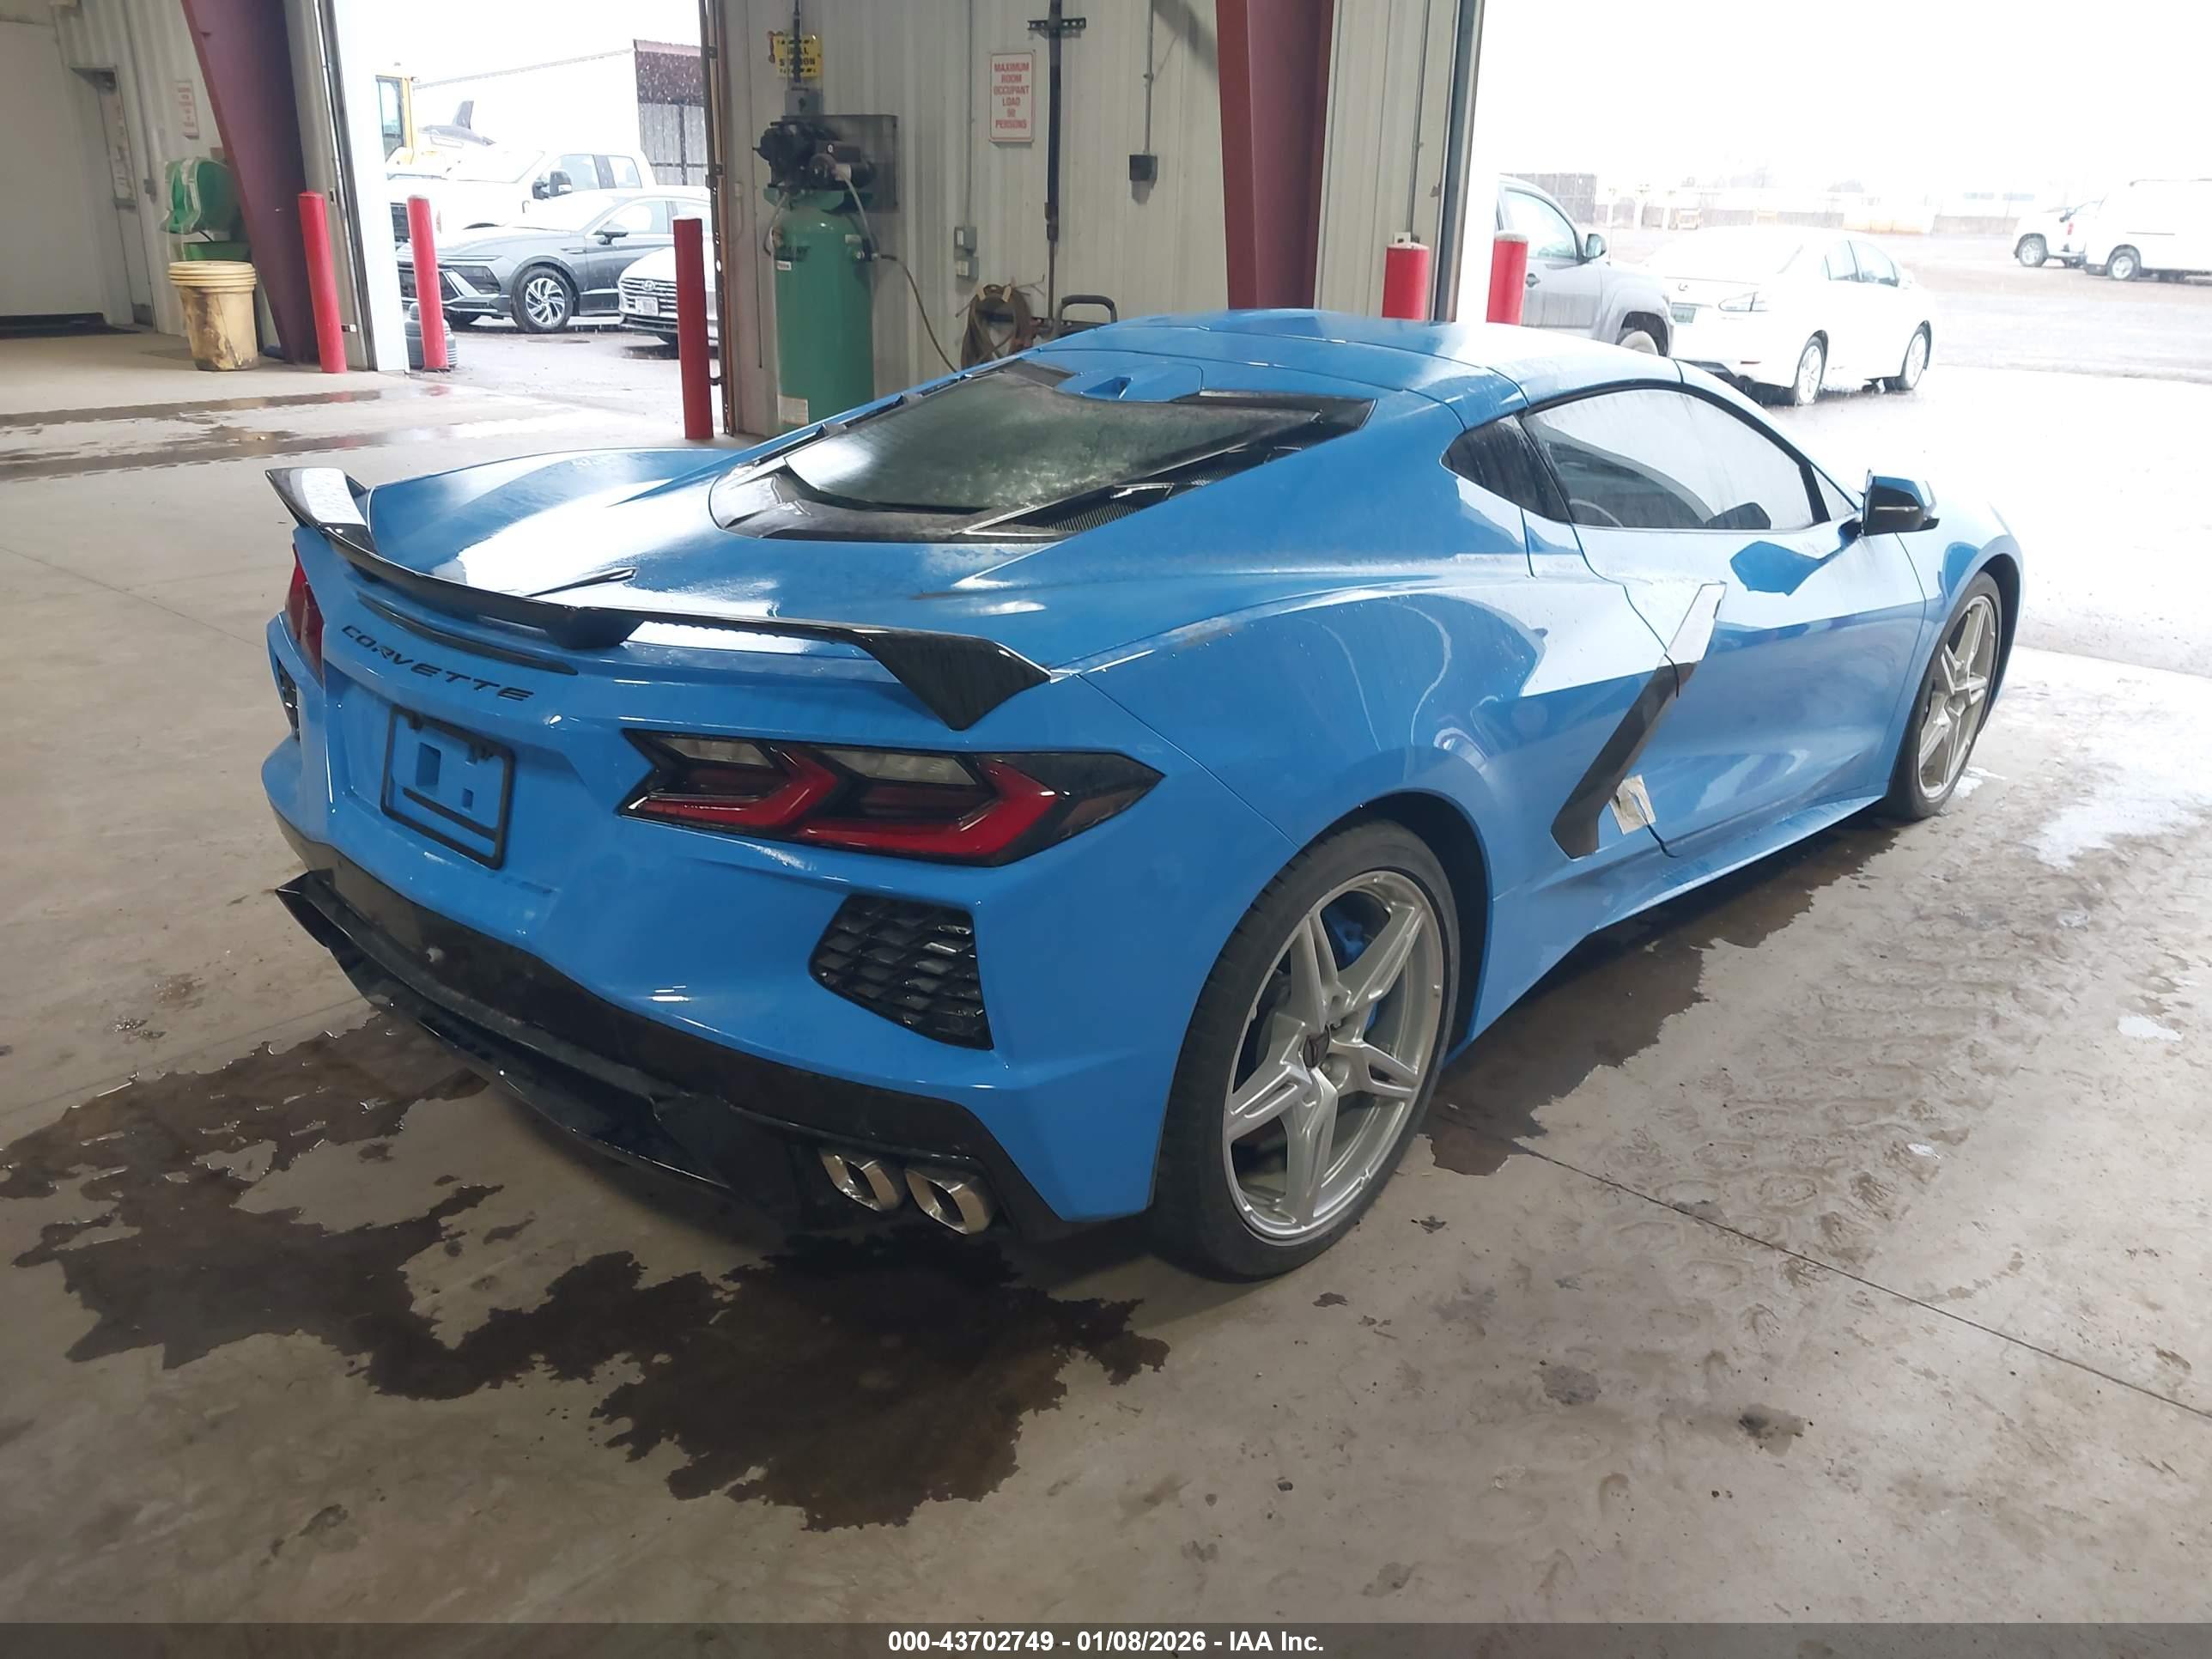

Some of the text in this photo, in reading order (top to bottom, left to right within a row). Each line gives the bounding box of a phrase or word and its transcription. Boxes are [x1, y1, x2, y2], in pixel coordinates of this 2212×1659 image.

[994, 62, 1030, 72] MAXIMUM
[1001, 74, 1022, 83] ROOM
[994, 85, 1030, 95] OCCUPANT
[1002, 97, 1021, 106] LOAD
[995, 119, 1027, 129] PERSONS
[342, 625, 534, 702] CORVETTE
